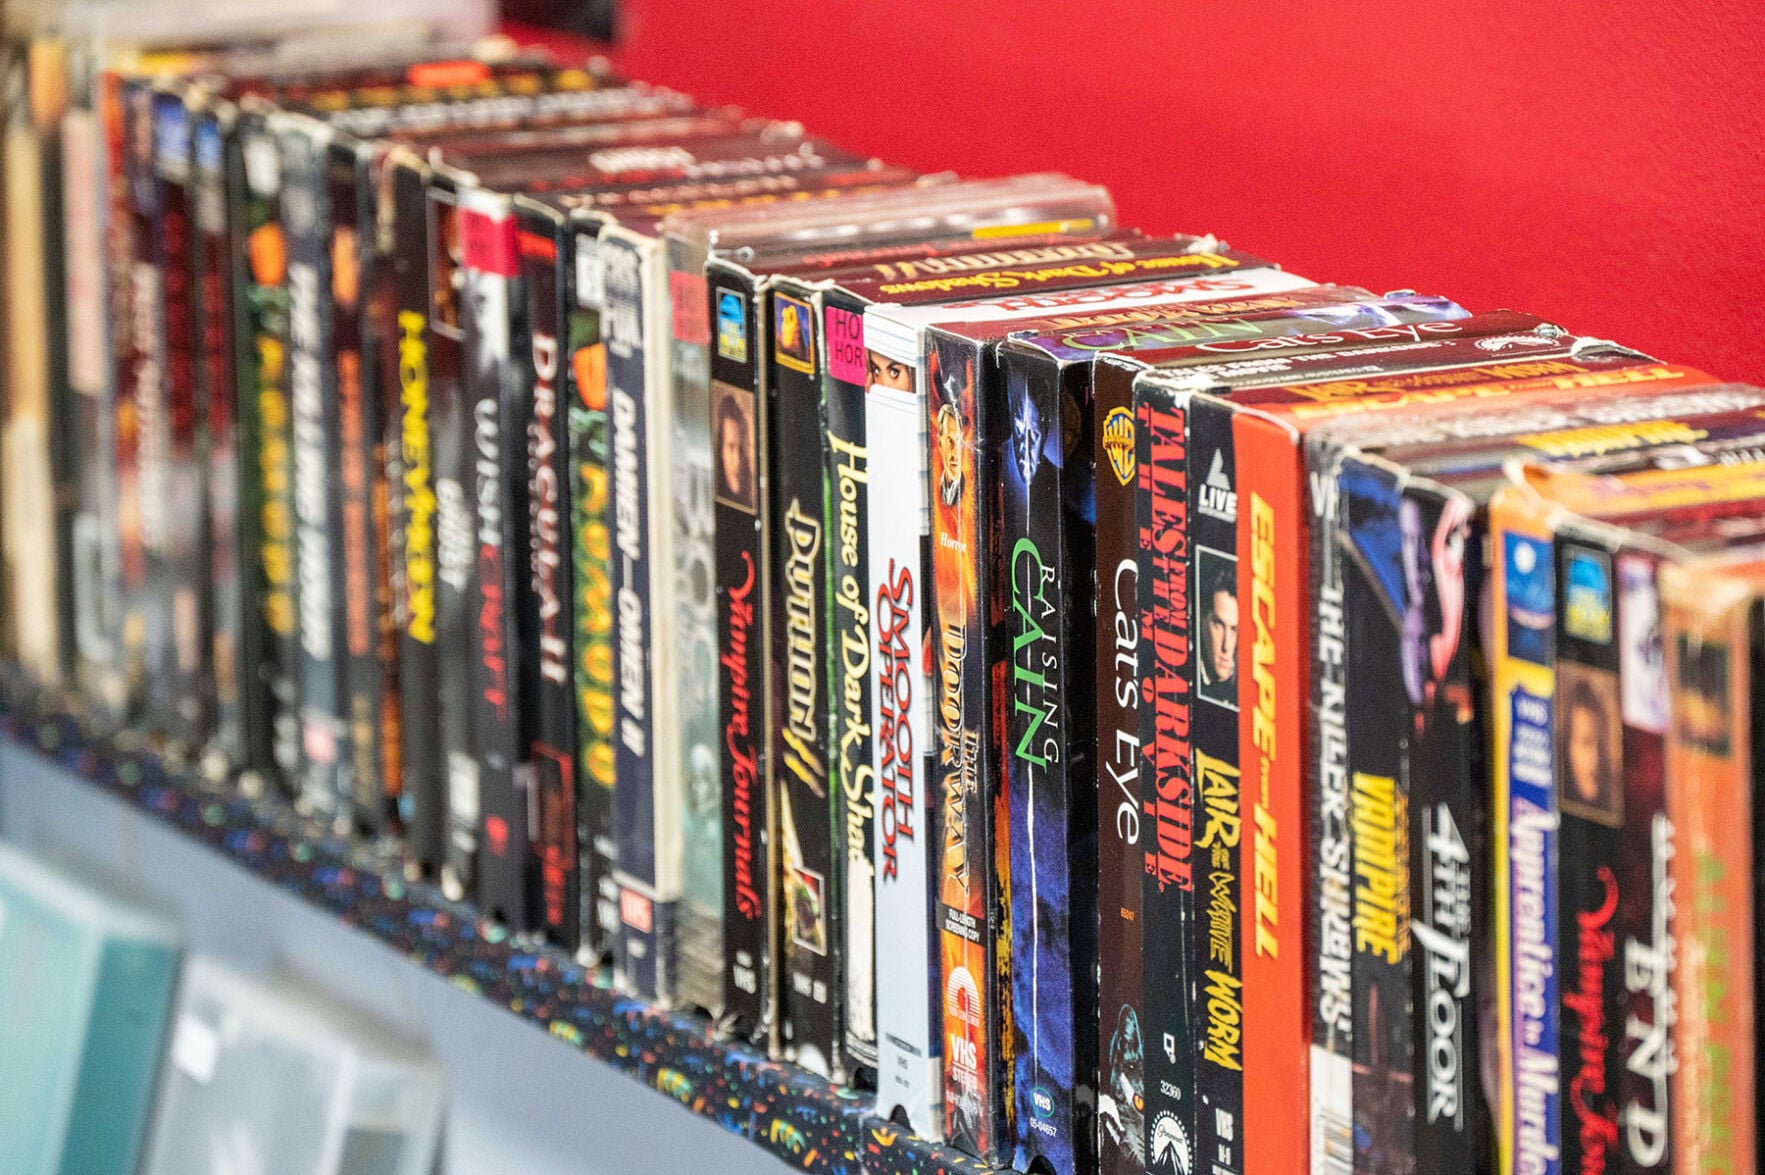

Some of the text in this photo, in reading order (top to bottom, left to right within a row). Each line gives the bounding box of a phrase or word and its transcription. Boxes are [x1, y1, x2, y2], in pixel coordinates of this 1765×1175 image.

[531, 331, 561, 621] DRACULA
[828, 430, 869, 568] House
[940, 531, 967, 553] Horror
[1150, 402, 1188, 628] TALES FROM
[1199, 483, 1238, 514] LIVE
[539, 631, 567, 685] II
[721, 551, 756, 737] Vampire
[785, 499, 820, 742] PYTHON
[835, 574, 869, 627] of
[1011, 537, 1048, 774] CAIN
[1040, 565, 1060, 764] RAISING
[1152, 557, 1171, 622] THE
[1251, 491, 1278, 762] ESCAPE
[841, 622, 872, 747] Dark
[877, 582, 898, 882] OPERATOR
[889, 558, 914, 839] SMOOTH
[1105, 558, 1141, 845] Cat's Eye
[726, 725, 762, 919] Journals
[1194, 748, 1242, 849] LAIR
[1350, 771, 1398, 965] VAMPIRE
[1252, 802, 1279, 960] HELL
[950, 1033, 977, 1071] VHS
[1160, 1080, 1182, 1100] 32360
[1203, 969, 1244, 1072] WORM
[1033, 1091, 1052, 1112] VHS
